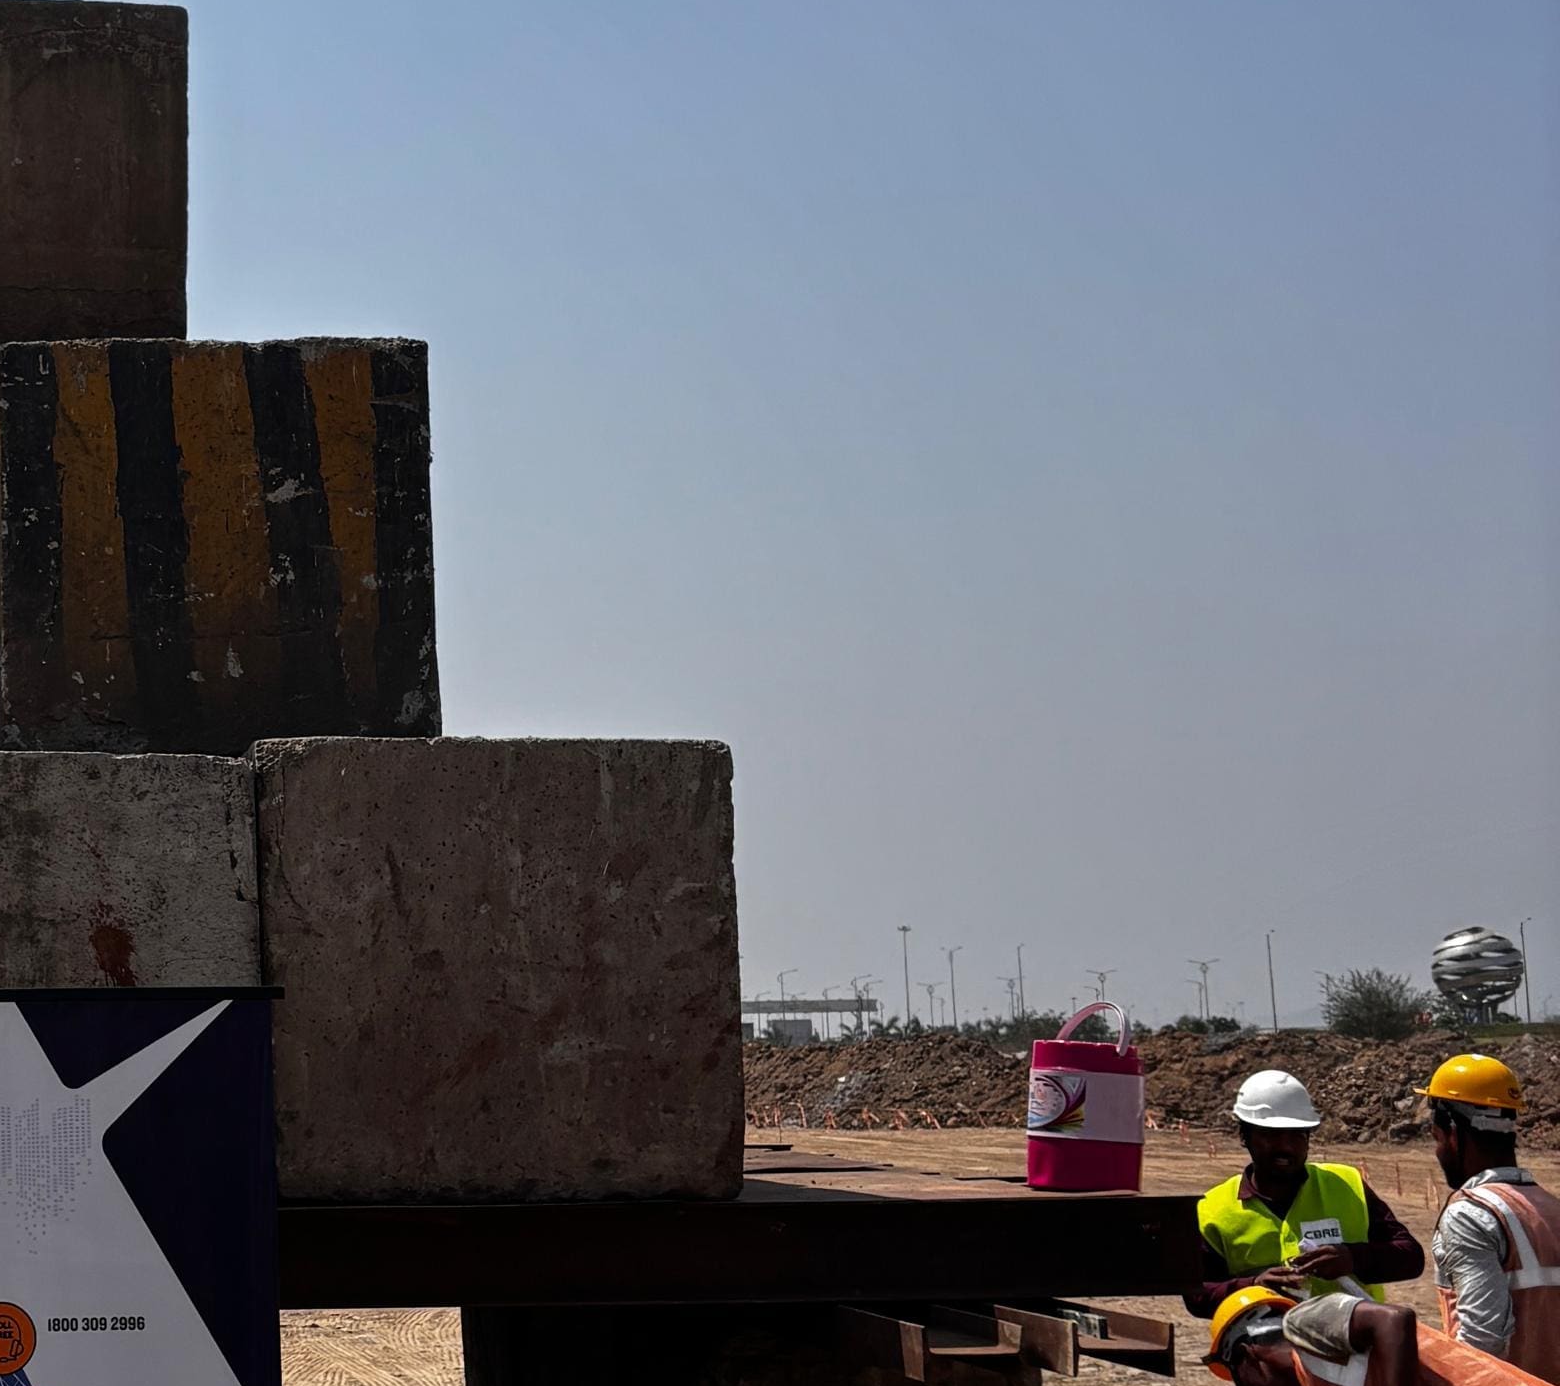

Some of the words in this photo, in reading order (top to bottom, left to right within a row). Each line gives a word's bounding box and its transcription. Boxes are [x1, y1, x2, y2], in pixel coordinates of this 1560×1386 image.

[48, 1317, 79, 1332] 1800
[82, 1317, 108, 1331] 309
[110, 1316, 145, 1331] 2996
